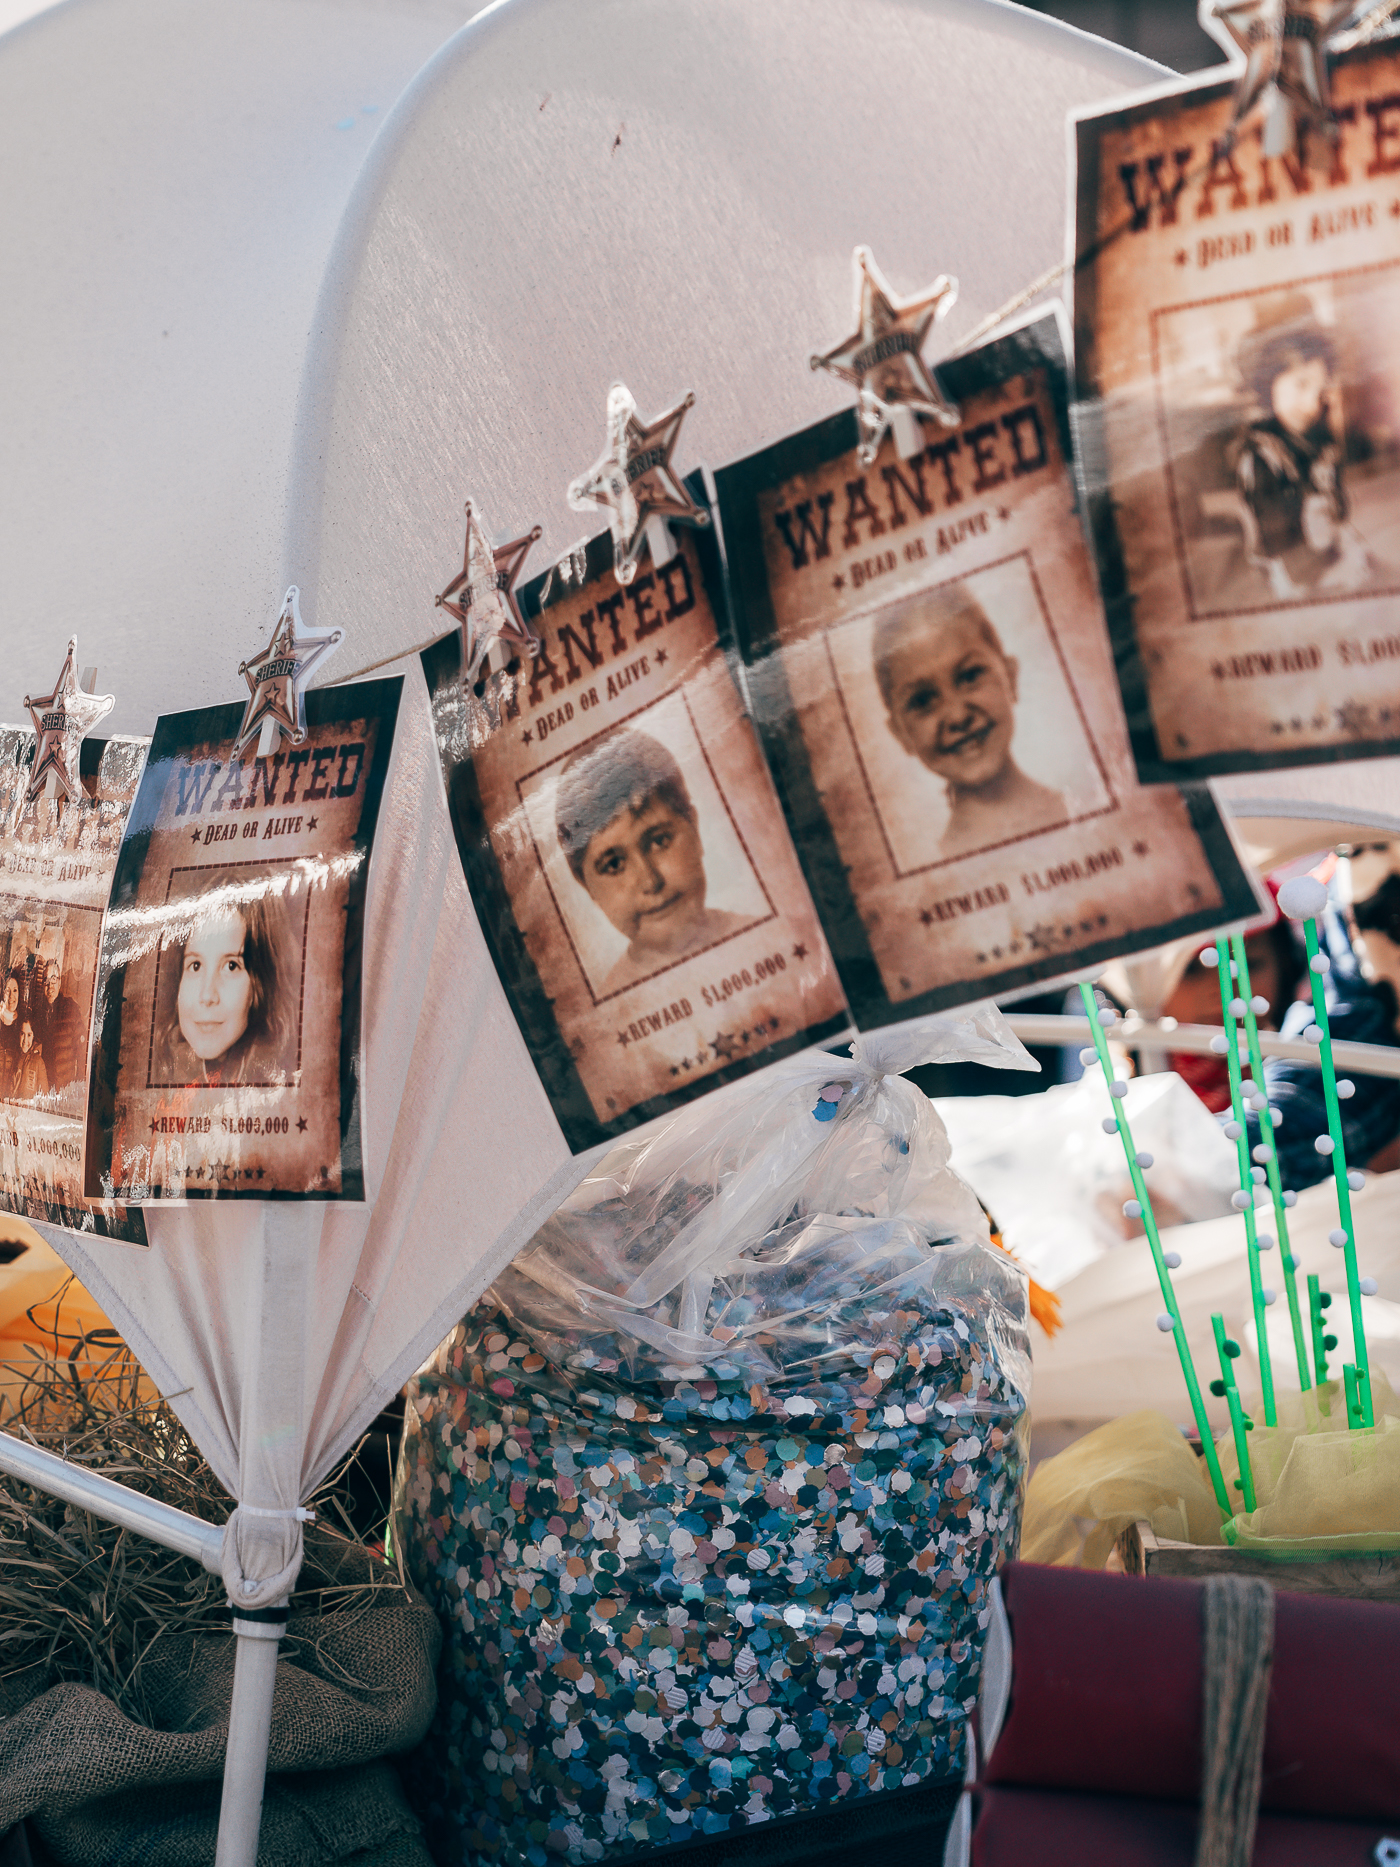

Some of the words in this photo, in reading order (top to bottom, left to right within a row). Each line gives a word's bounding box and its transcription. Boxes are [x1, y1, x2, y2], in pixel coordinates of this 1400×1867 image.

[775, 404, 1048, 570] WANTED
[851, 551, 897, 588] DEAD
[936, 511, 989, 556] ALIVE
[537, 701, 574, 742] DEAD
[581, 687, 600, 711] OR
[607, 657, 650, 701] ALIVE
[174, 743, 367, 817] WANTED
[203, 824, 237, 845] DEAD
[242, 820, 258, 839] OR
[262, 816, 303, 840] ALIVE
[628, 998, 693, 1041] REWARD
[701, 952, 787, 1007] $1,000,000
[160, 1117, 211, 1134] REWARD
[221, 1116, 289, 1136] $1,000,000
